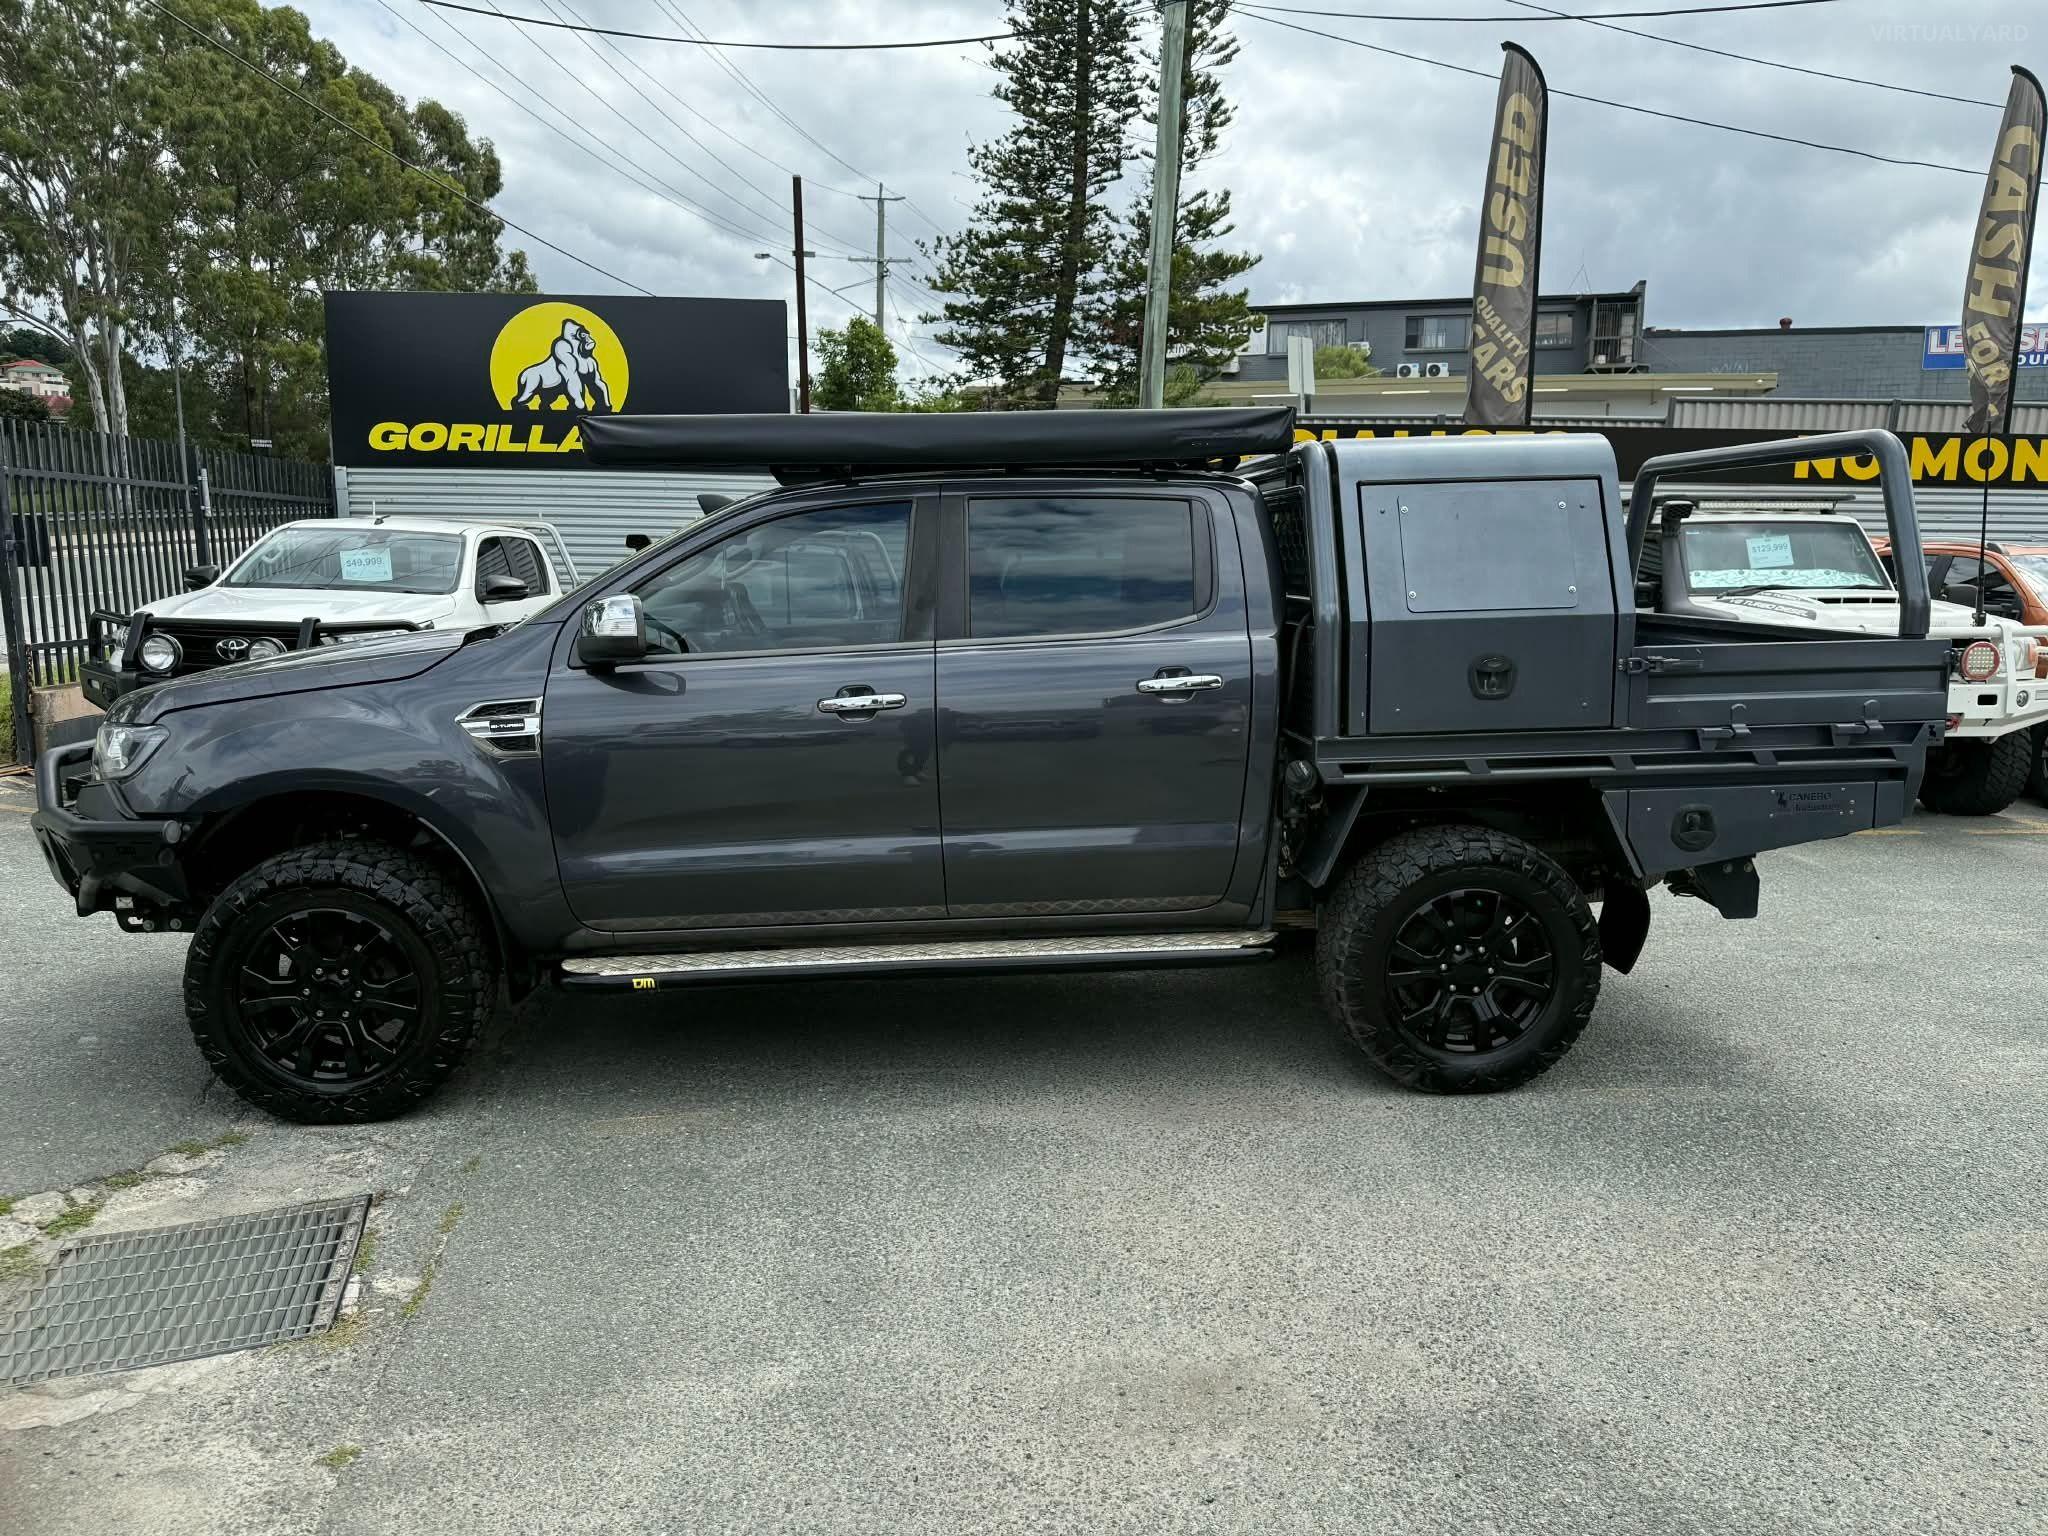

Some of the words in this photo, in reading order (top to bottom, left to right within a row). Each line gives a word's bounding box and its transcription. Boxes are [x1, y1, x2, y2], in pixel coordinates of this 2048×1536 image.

[1482, 92, 1537, 288] USED
[1967, 124, 2040, 318] CASH
[1476, 295, 1529, 357] QUALITY
[1966, 320, 2011, 389] FOR
[368, 421, 585, 453] GORILLA
